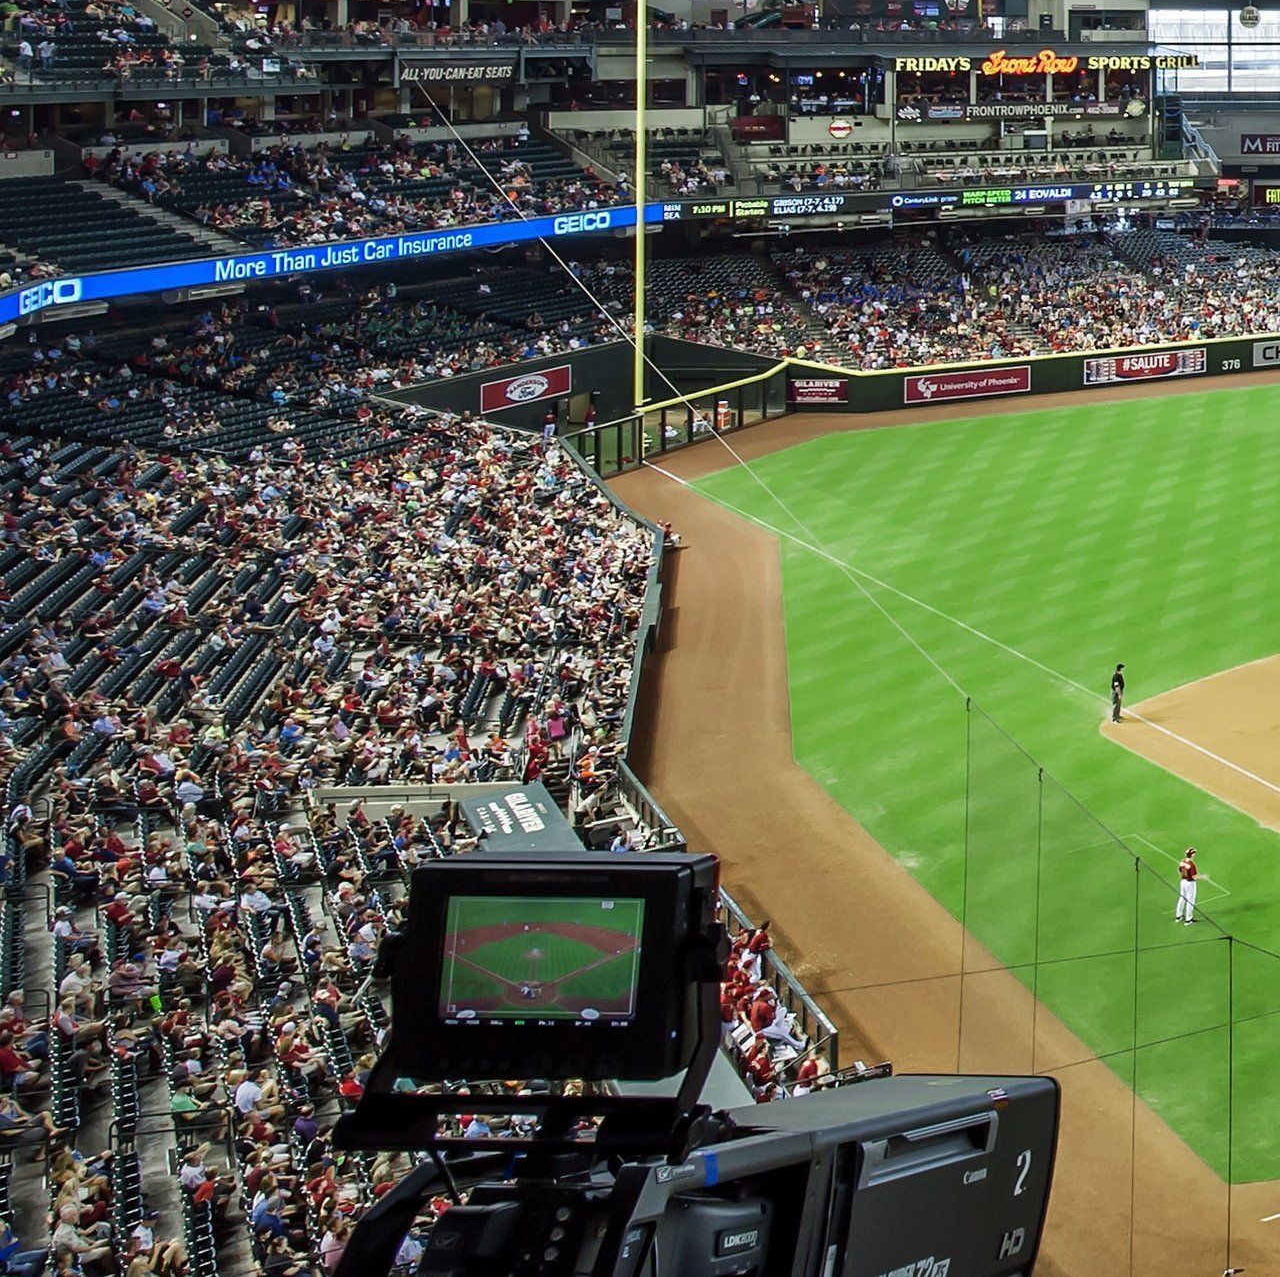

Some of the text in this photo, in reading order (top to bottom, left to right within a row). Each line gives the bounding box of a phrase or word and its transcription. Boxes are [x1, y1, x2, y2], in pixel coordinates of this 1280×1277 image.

[895, 49, 1198, 74] FRIDAY'S Front Row SPORTS GRILL
[486, 66, 512, 78] SEATS
[966, 104, 1084, 116] FRONTROWPHOENIX.com
[1015, 189, 1071, 200] 24 EOVALDI
[554, 212, 610, 235] GEICO
[215, 232, 473, 281] More Than Just Car Insurance
[19, 278, 82, 315] GEICO
[1123, 355, 1170, 371] #SALUTE
[1222, 360, 1240, 370] 376
[940, 381, 977, 391] University
[963, 1168, 987, 1185] Canon
[1014, 1150, 1031, 1196] 2
[1000, 1227, 1025, 1259] HD
